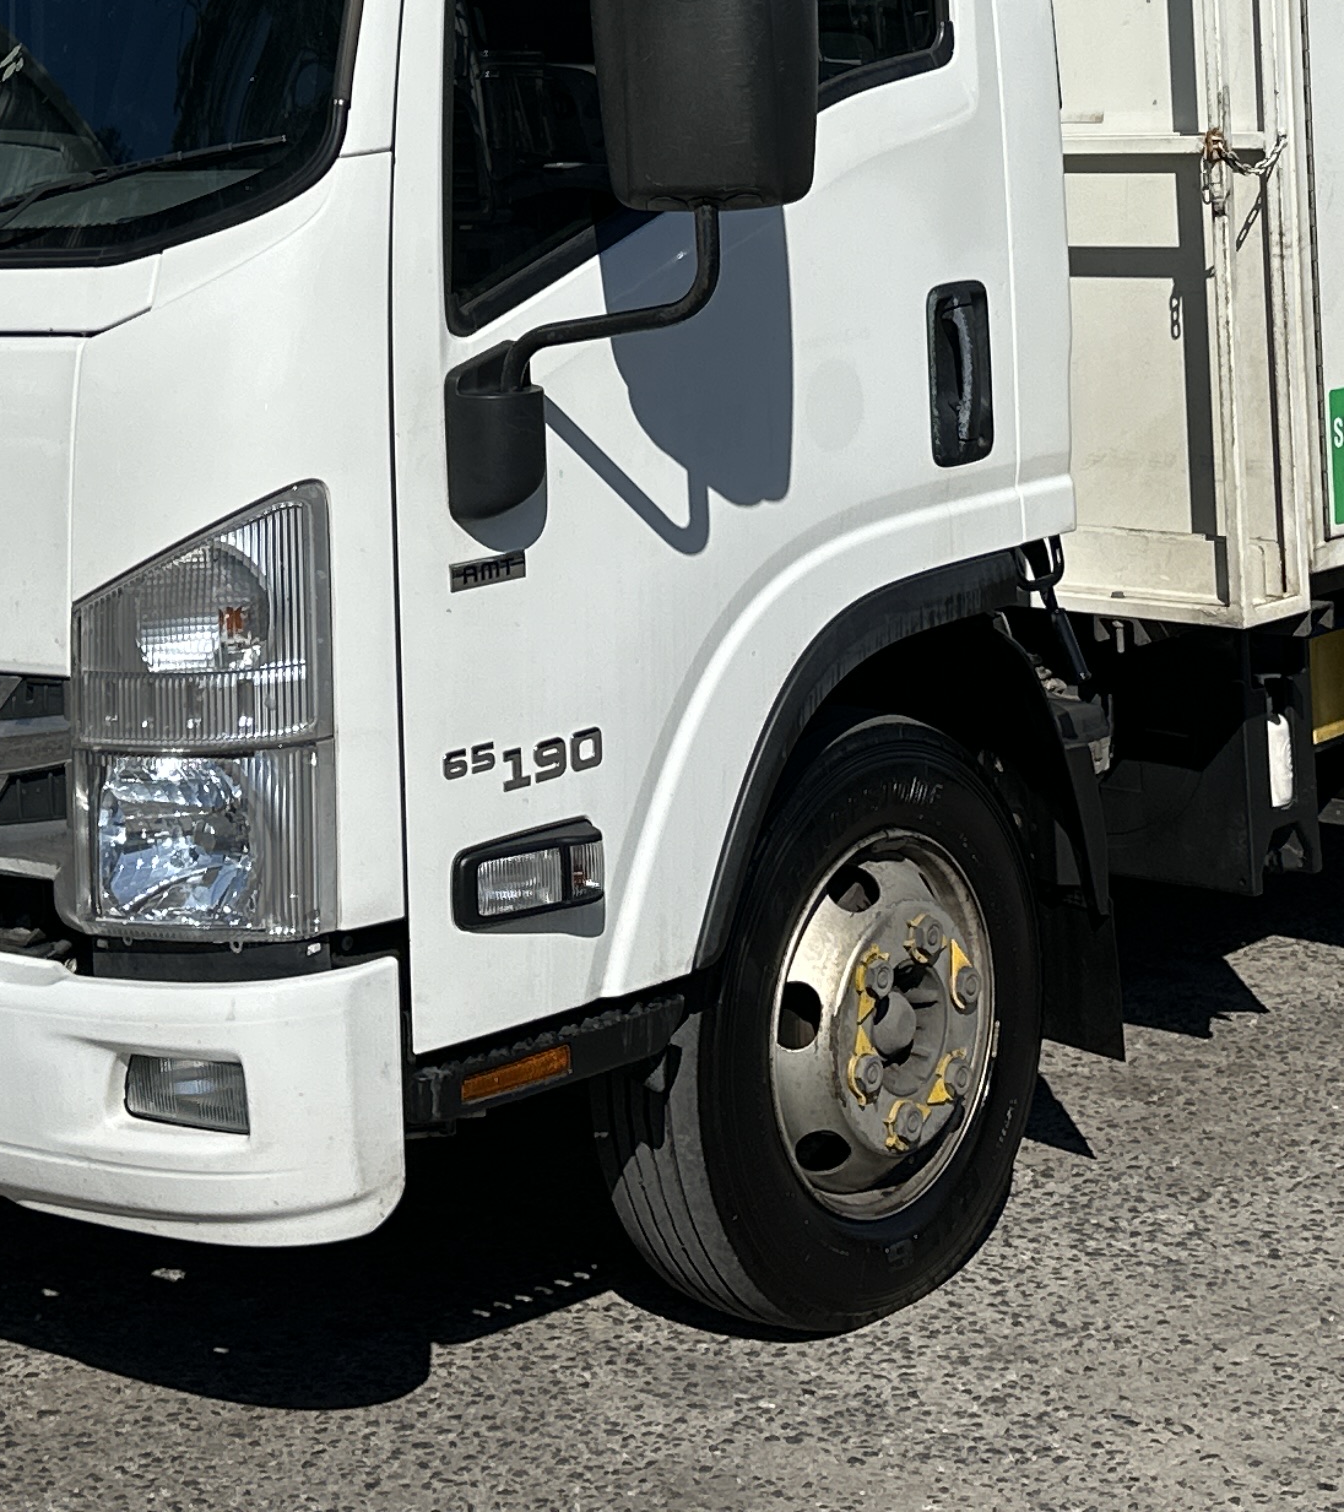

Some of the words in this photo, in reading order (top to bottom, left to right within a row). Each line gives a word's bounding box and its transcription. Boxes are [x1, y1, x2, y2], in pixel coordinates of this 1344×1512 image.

[462, 557, 515, 585] AMT
[442, 741, 496, 781] 65
[502, 726, 603, 793] 190
